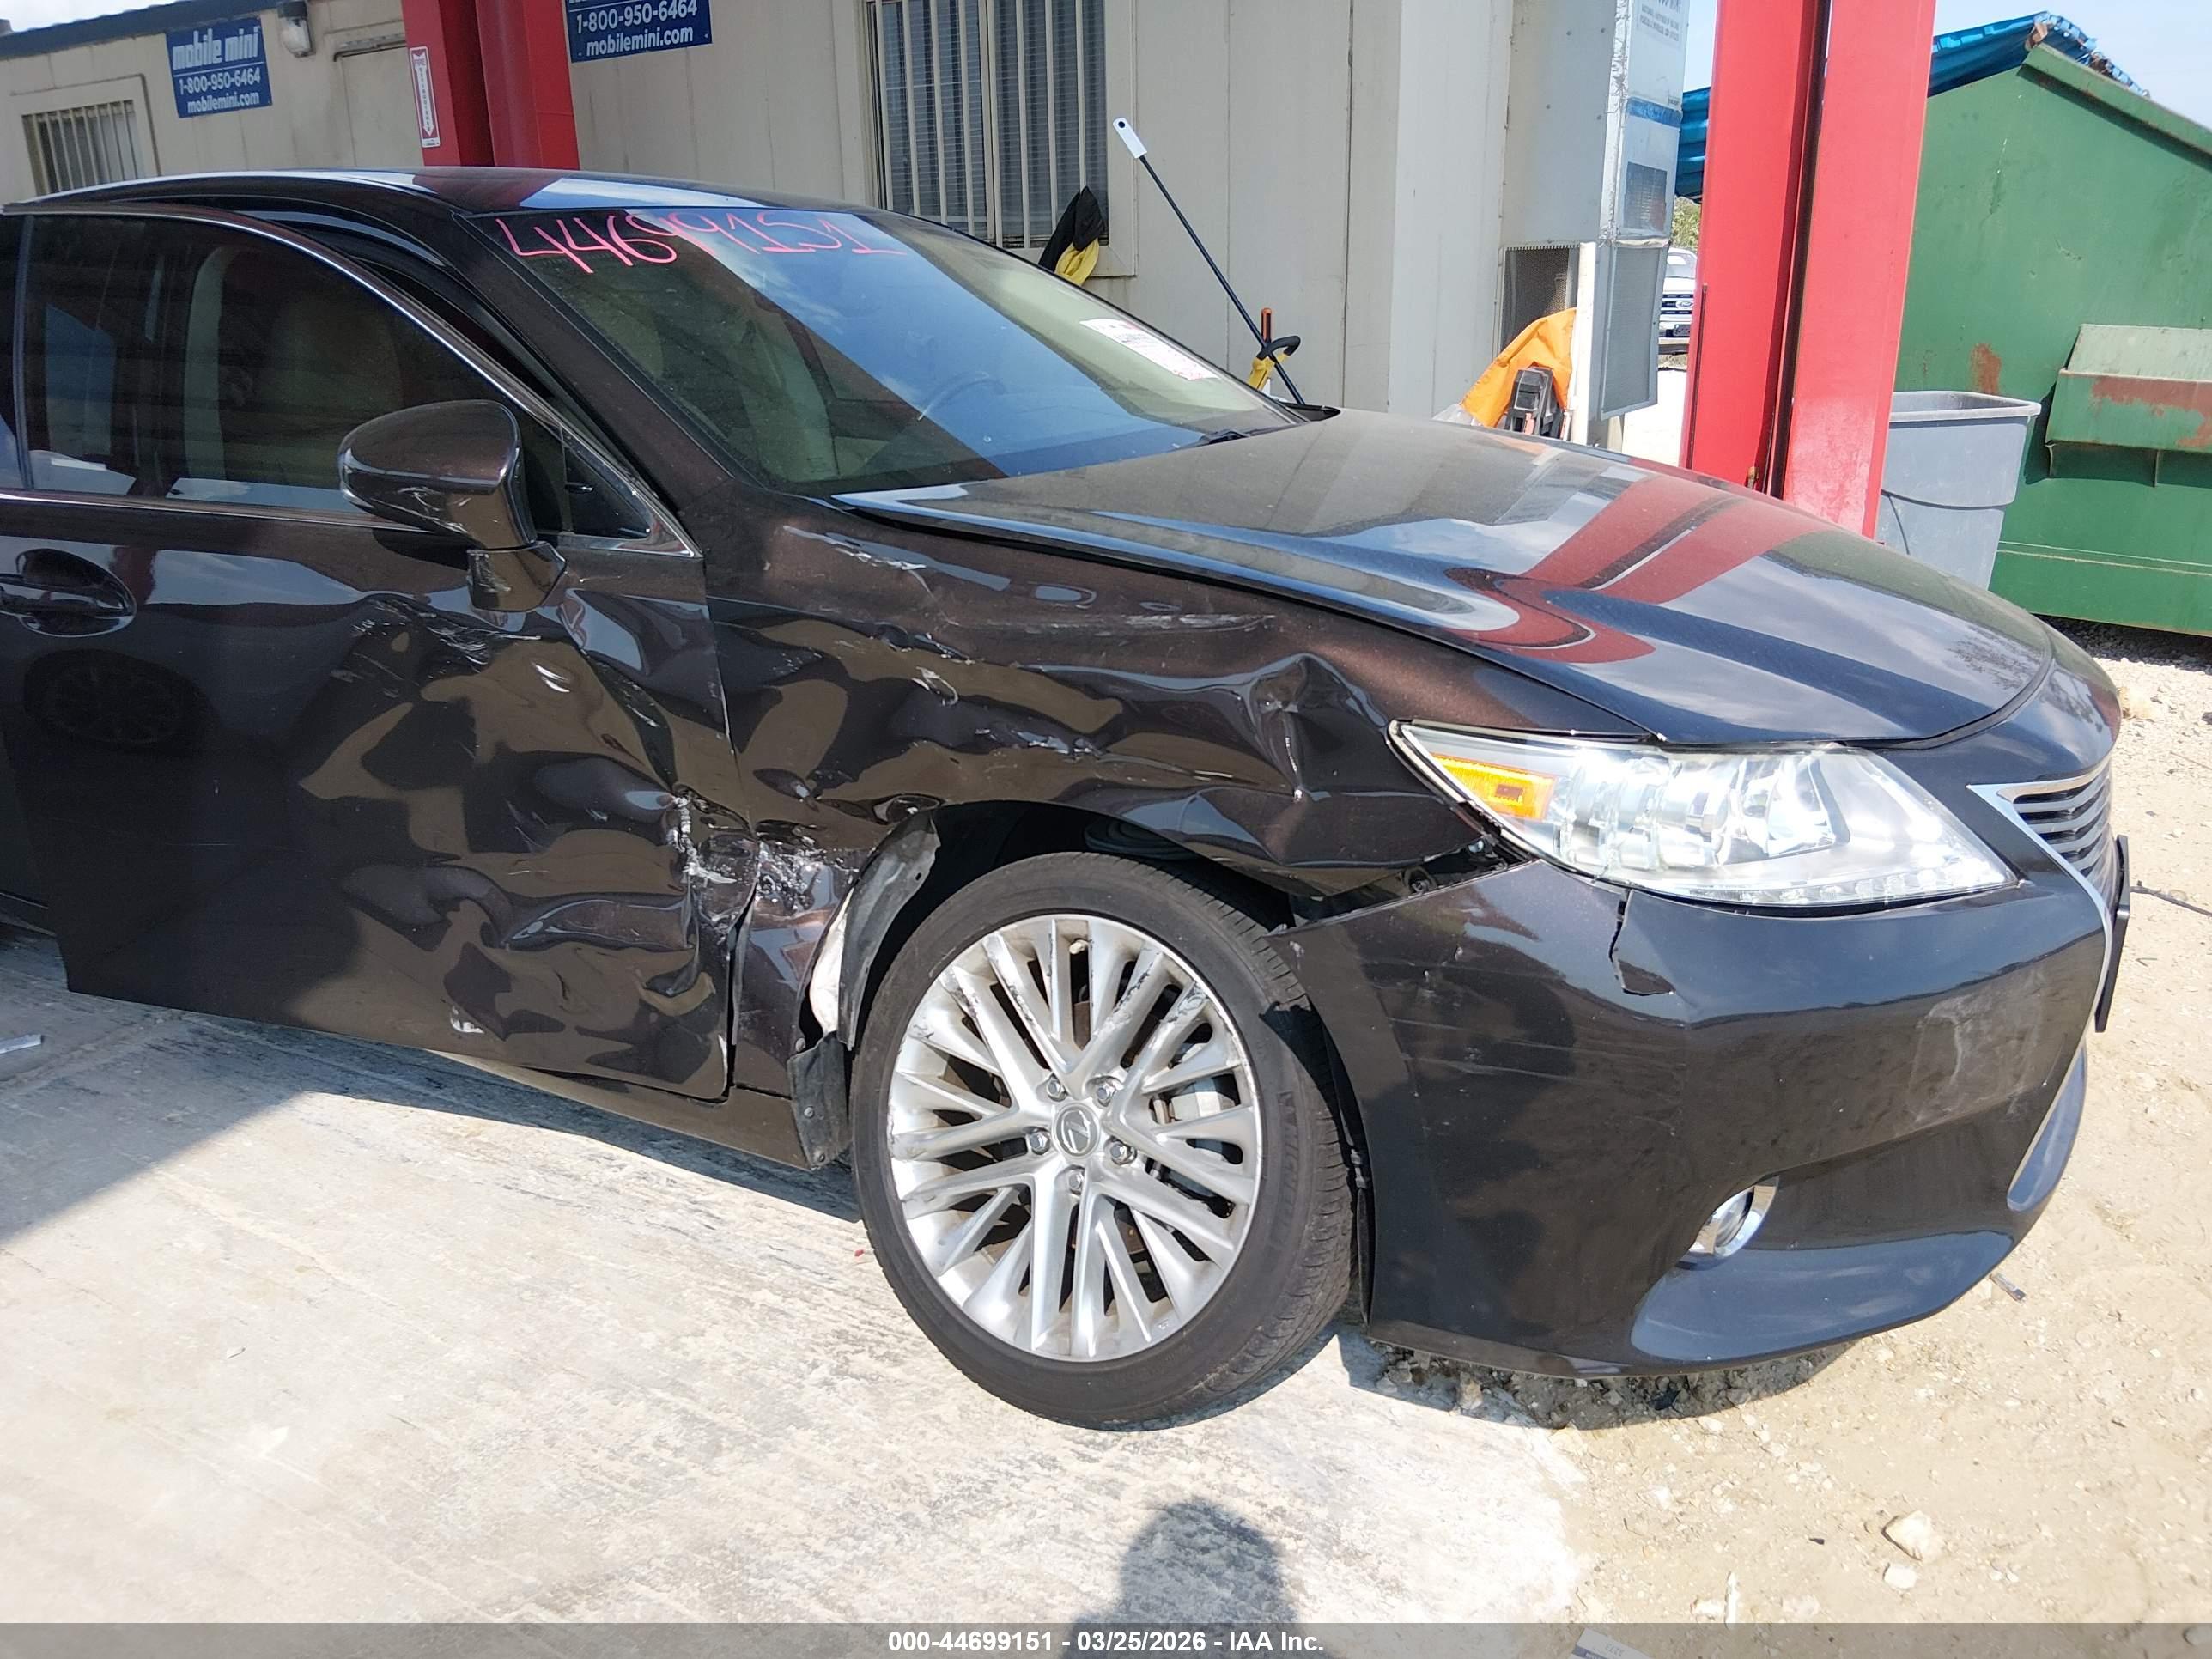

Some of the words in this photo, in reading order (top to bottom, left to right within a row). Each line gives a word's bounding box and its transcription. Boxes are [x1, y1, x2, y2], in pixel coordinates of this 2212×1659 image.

[576, 0, 697, 33] 1-800-950-6464
[173, 28, 222, 70] mobile
[225, 26, 260, 62] mini
[586, 26, 694, 57] mobilemini.com
[179, 67, 261, 94] 1-800-950-6464
[187, 91, 260, 113] mobilemini.com
[495, 211, 907, 274] 44699151
